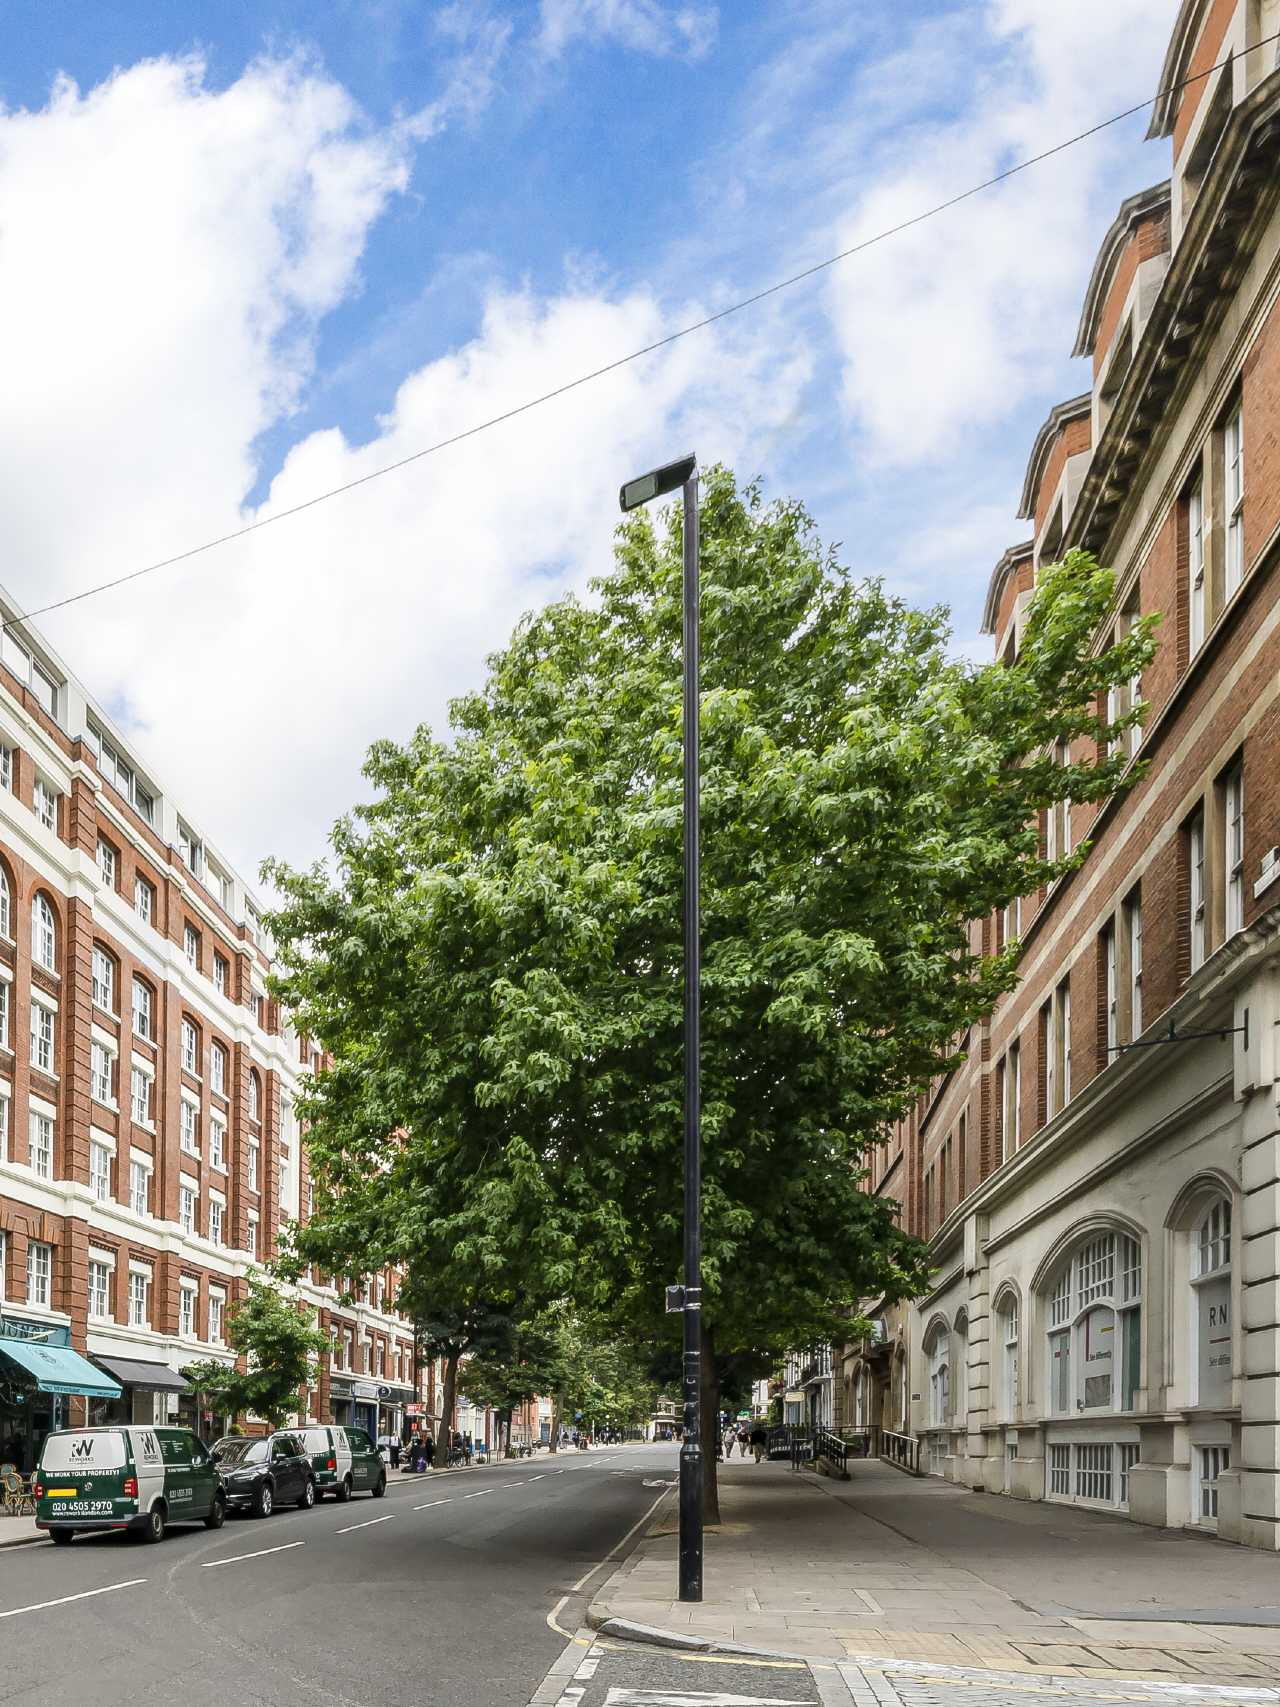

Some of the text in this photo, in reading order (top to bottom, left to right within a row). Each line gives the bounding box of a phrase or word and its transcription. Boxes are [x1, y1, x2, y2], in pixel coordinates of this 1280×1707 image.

[52, 1500, 113, 1511] 020 4505 2970
